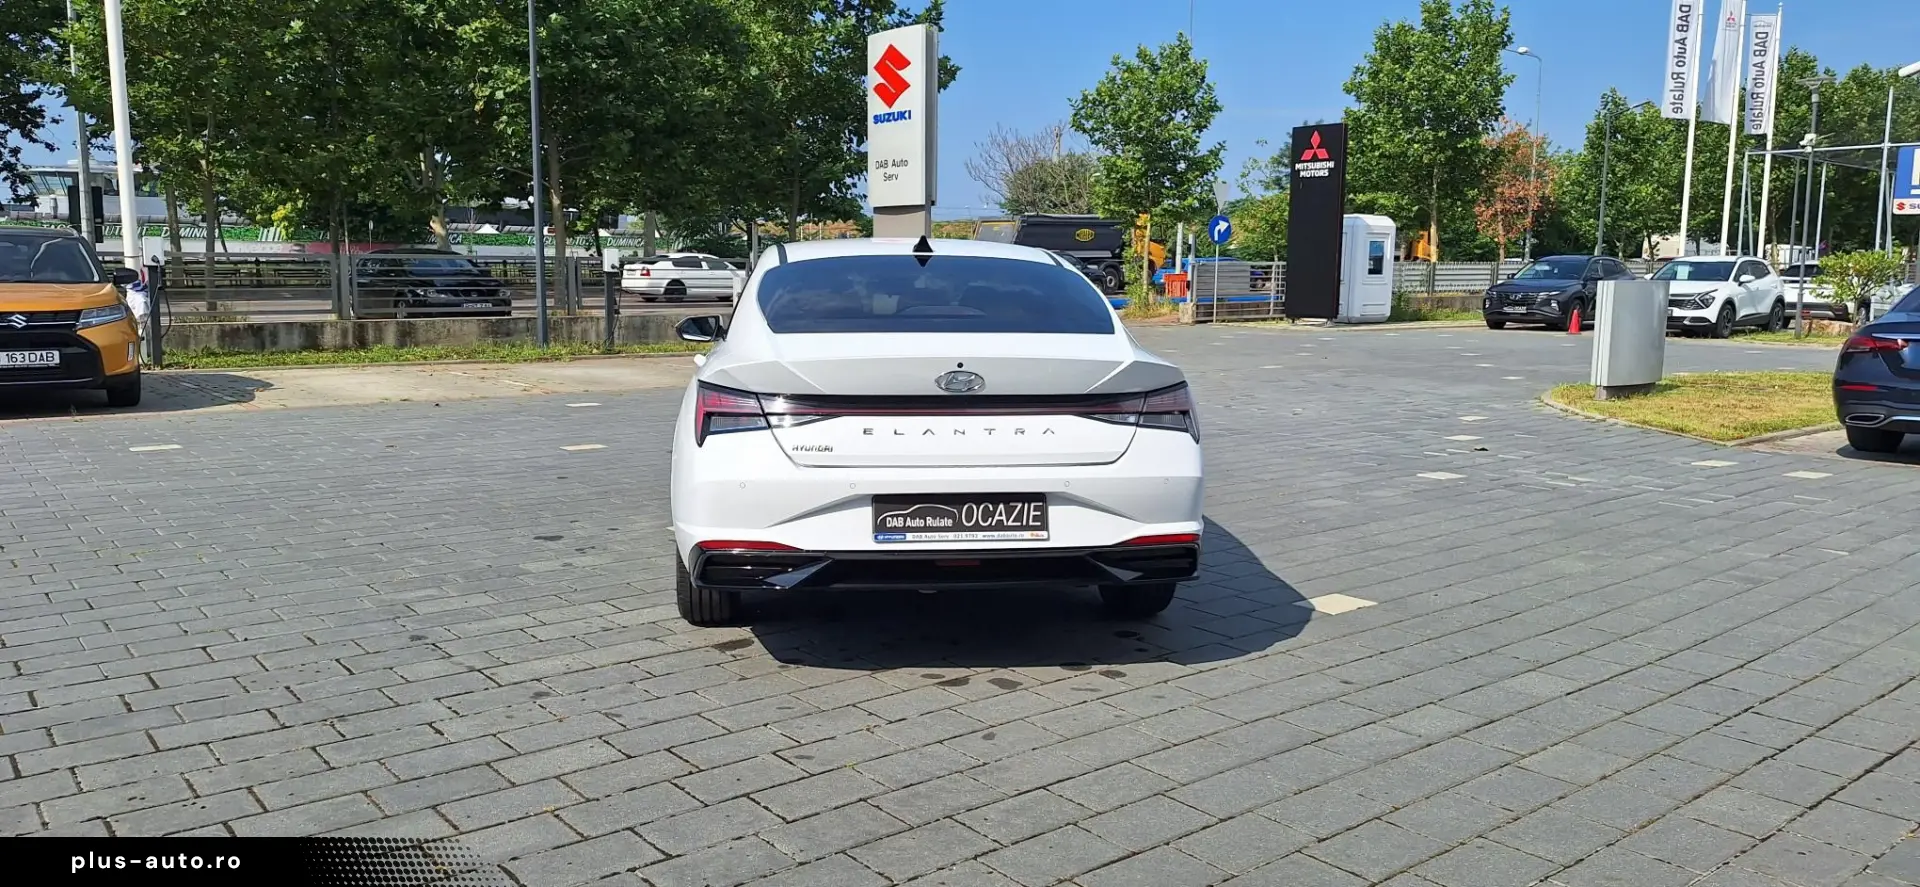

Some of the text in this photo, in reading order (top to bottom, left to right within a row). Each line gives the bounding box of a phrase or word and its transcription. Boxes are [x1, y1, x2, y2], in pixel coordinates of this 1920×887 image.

[873, 109, 912, 125] SUZUKI
[875, 158, 909, 170] DAB Auto
[1295, 161, 1335, 170] MITSUBISHI
[883, 172, 899, 182] Serv
[1299, 169, 1329, 178] MOTORS
[5, 351, 55, 364] 163 DAB
[863, 427, 1055, 436] ELANTRA
[791, 444, 834, 452] HYUNDAI
[886, 502, 1043, 527] DAB Auto Rulate OCAZIE
